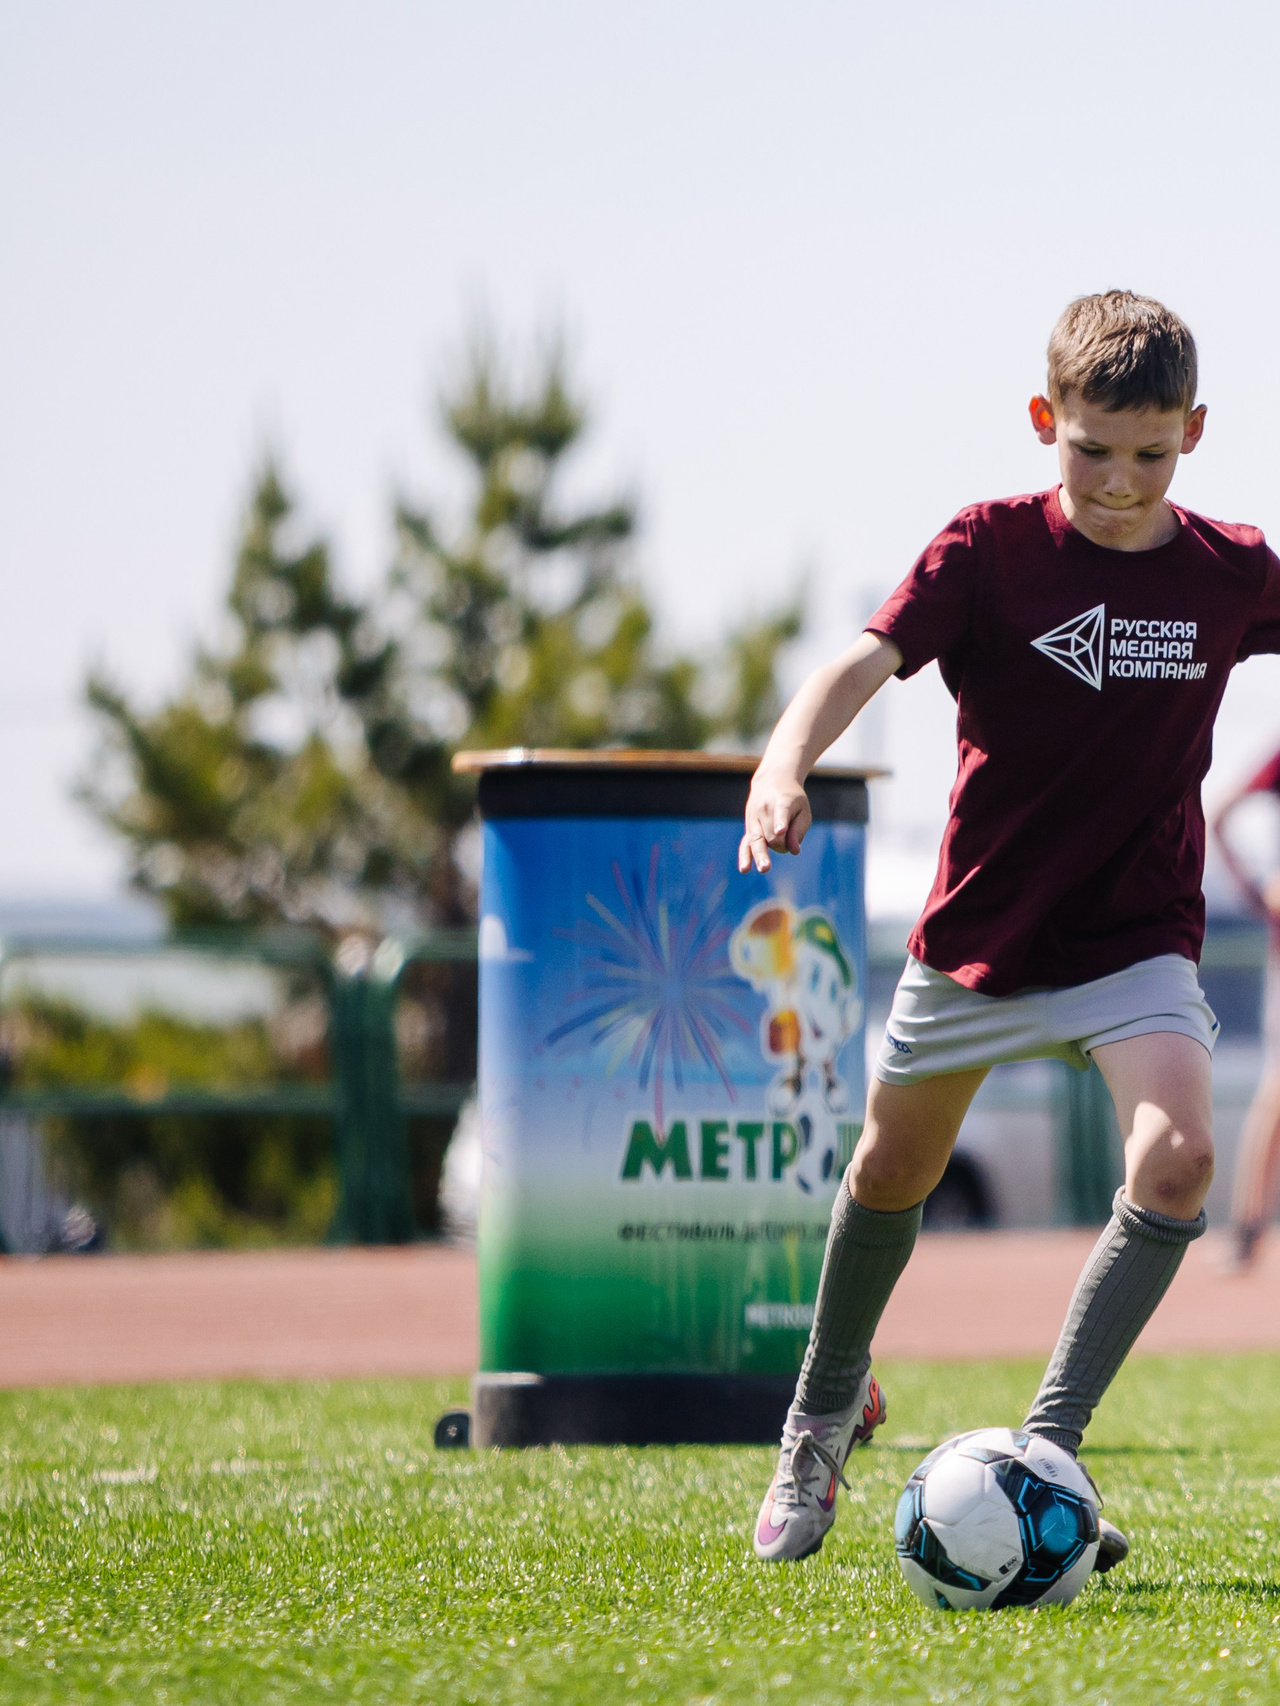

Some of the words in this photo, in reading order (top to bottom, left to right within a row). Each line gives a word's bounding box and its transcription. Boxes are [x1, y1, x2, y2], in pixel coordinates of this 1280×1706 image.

[1110, 618, 1197, 640] РУССКАЯ
[1109, 639, 1194, 659] МЕДНАЯ
[1108, 659, 1208, 680] КОМПАНИЯ
